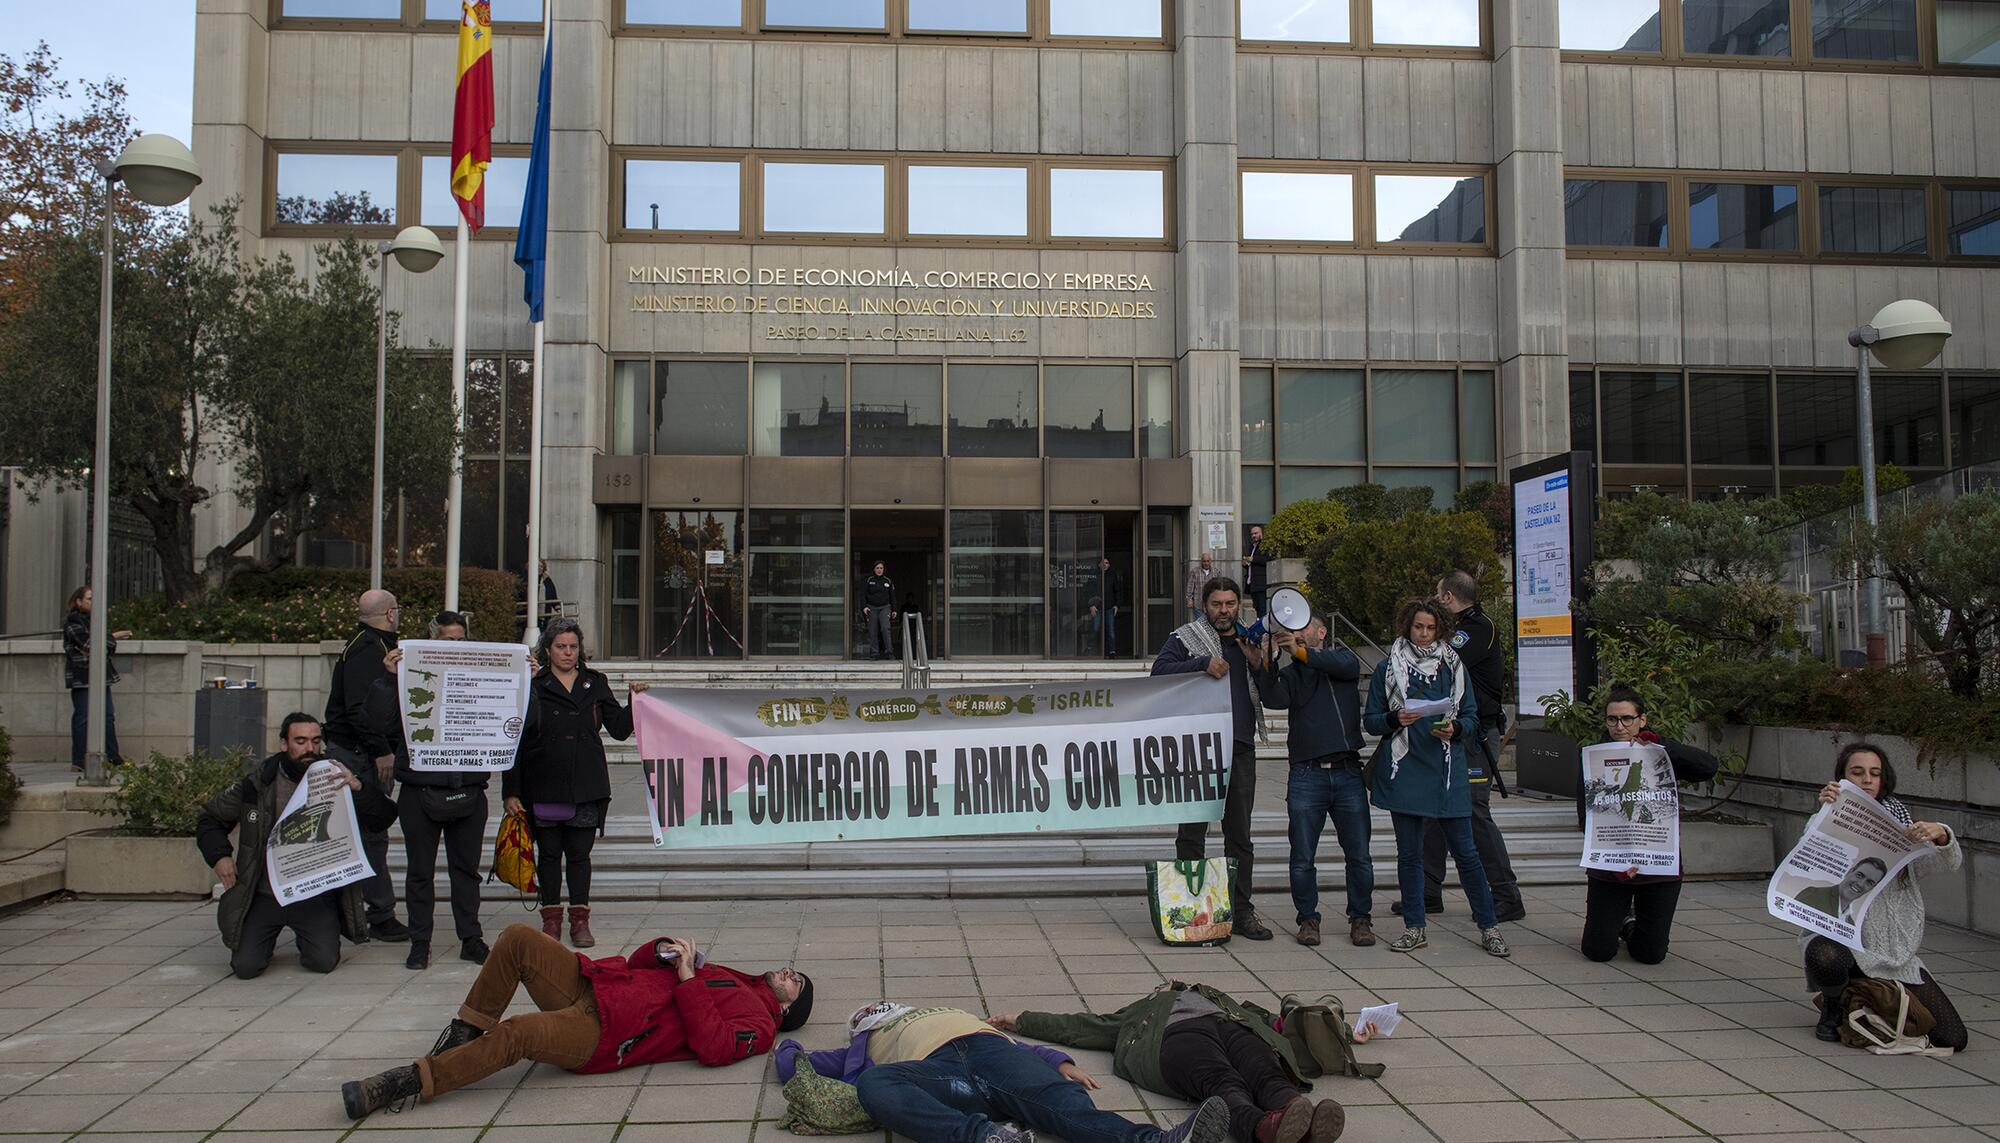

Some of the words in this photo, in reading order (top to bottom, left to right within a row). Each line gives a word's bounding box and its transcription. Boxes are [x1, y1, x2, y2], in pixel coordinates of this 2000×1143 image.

[628, 266, 751, 286] MINISTERIO
[758, 268, 787, 287] DE
[793, 265, 919, 290] ECONOMÍA,
[924, 270, 1041, 290] COMERCIO
[1043, 272, 1058, 290] Y
[1064, 273, 1153, 292] EMPRESA
[632, 294, 737, 313] MINISTERIO
[743, 296, 768, 314] DE
[774, 297, 855, 317] CIENCIA,
[860, 295, 981, 317] INNOVACIÓN
[992, 299, 1004, 317] Y
[1011, 299, 1155, 319] UNIVERSIDADES
[766, 325, 819, 340] PASEO
[827, 326, 849, 340] DE
[1001, 327, 1026, 342] 162
[1527, 504, 1542, 515] PASEO
[1543, 502, 1550, 512] DE
[1550, 501, 1556, 510] LA
[1524, 516, 1552, 530] CASTELLANA
[772, 703, 801, 723] FIN
[804, 703, 817, 714] AL
[862, 703, 916, 718] COMERCIO
[956, 701, 970, 711] DE
[972, 700, 1006, 711] ARMAS
[1050, 689, 1114, 711] ISRAEL
[440, 749, 478, 757] NECESITAMOS
[489, 748, 516, 757] EMBARGO
[421, 758, 453, 766] INTEGRAL
[459, 758, 483, 766] ARMAS
[701, 756, 733, 826] AL
[747, 750, 890, 826] COMERCIO
[905, 749, 939, 818] DE
[953, 743, 1050, 816] ARMAS
[1064, 740, 1119, 811] CON
[1133, 732, 1227, 805] ISRAEL
[1612, 767, 1621, 783] 7
[1621, 790, 1672, 802] ASESINATOS
